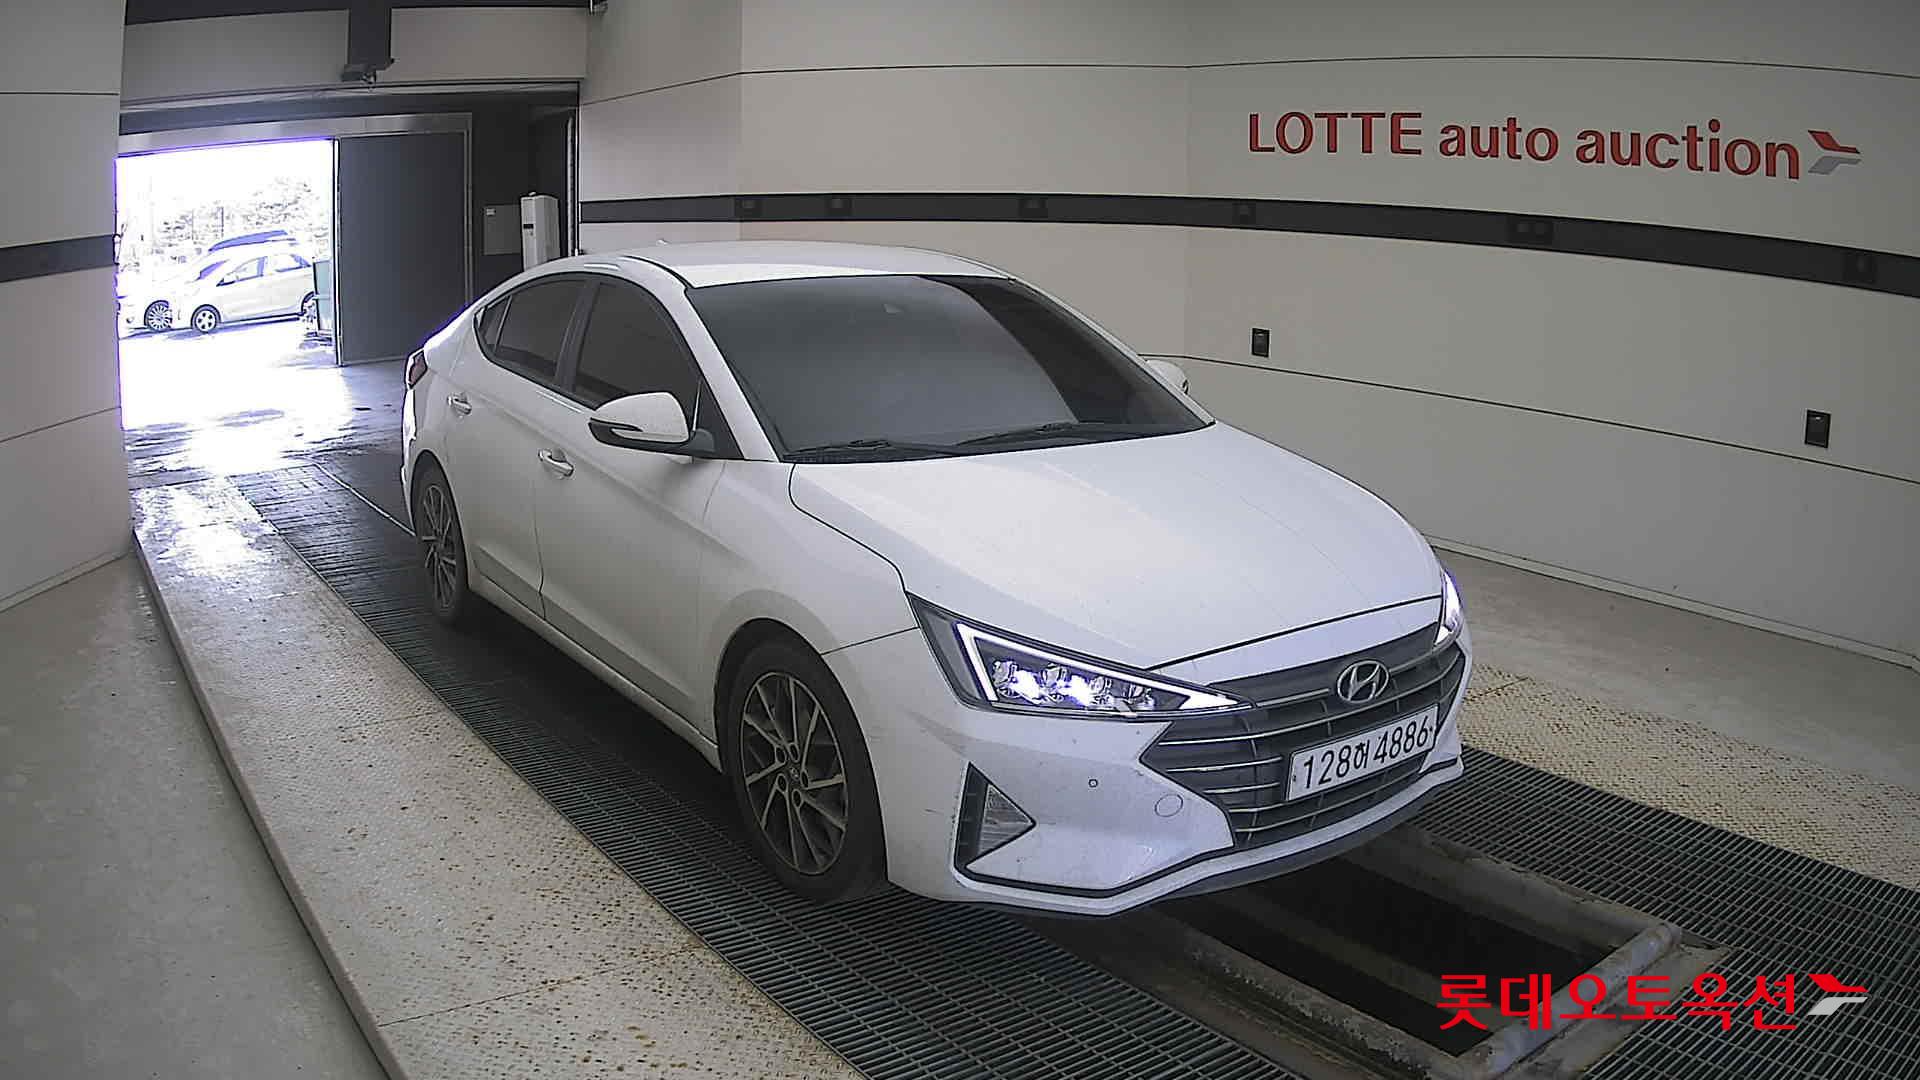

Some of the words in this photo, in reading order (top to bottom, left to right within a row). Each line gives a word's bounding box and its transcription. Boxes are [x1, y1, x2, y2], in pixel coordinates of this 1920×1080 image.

[1248, 111, 1422, 155] LOTTE
[1439, 116, 1560, 162] auto
[1575, 118, 1801, 180] auction
[1373, 715, 1429, 764] 4886
